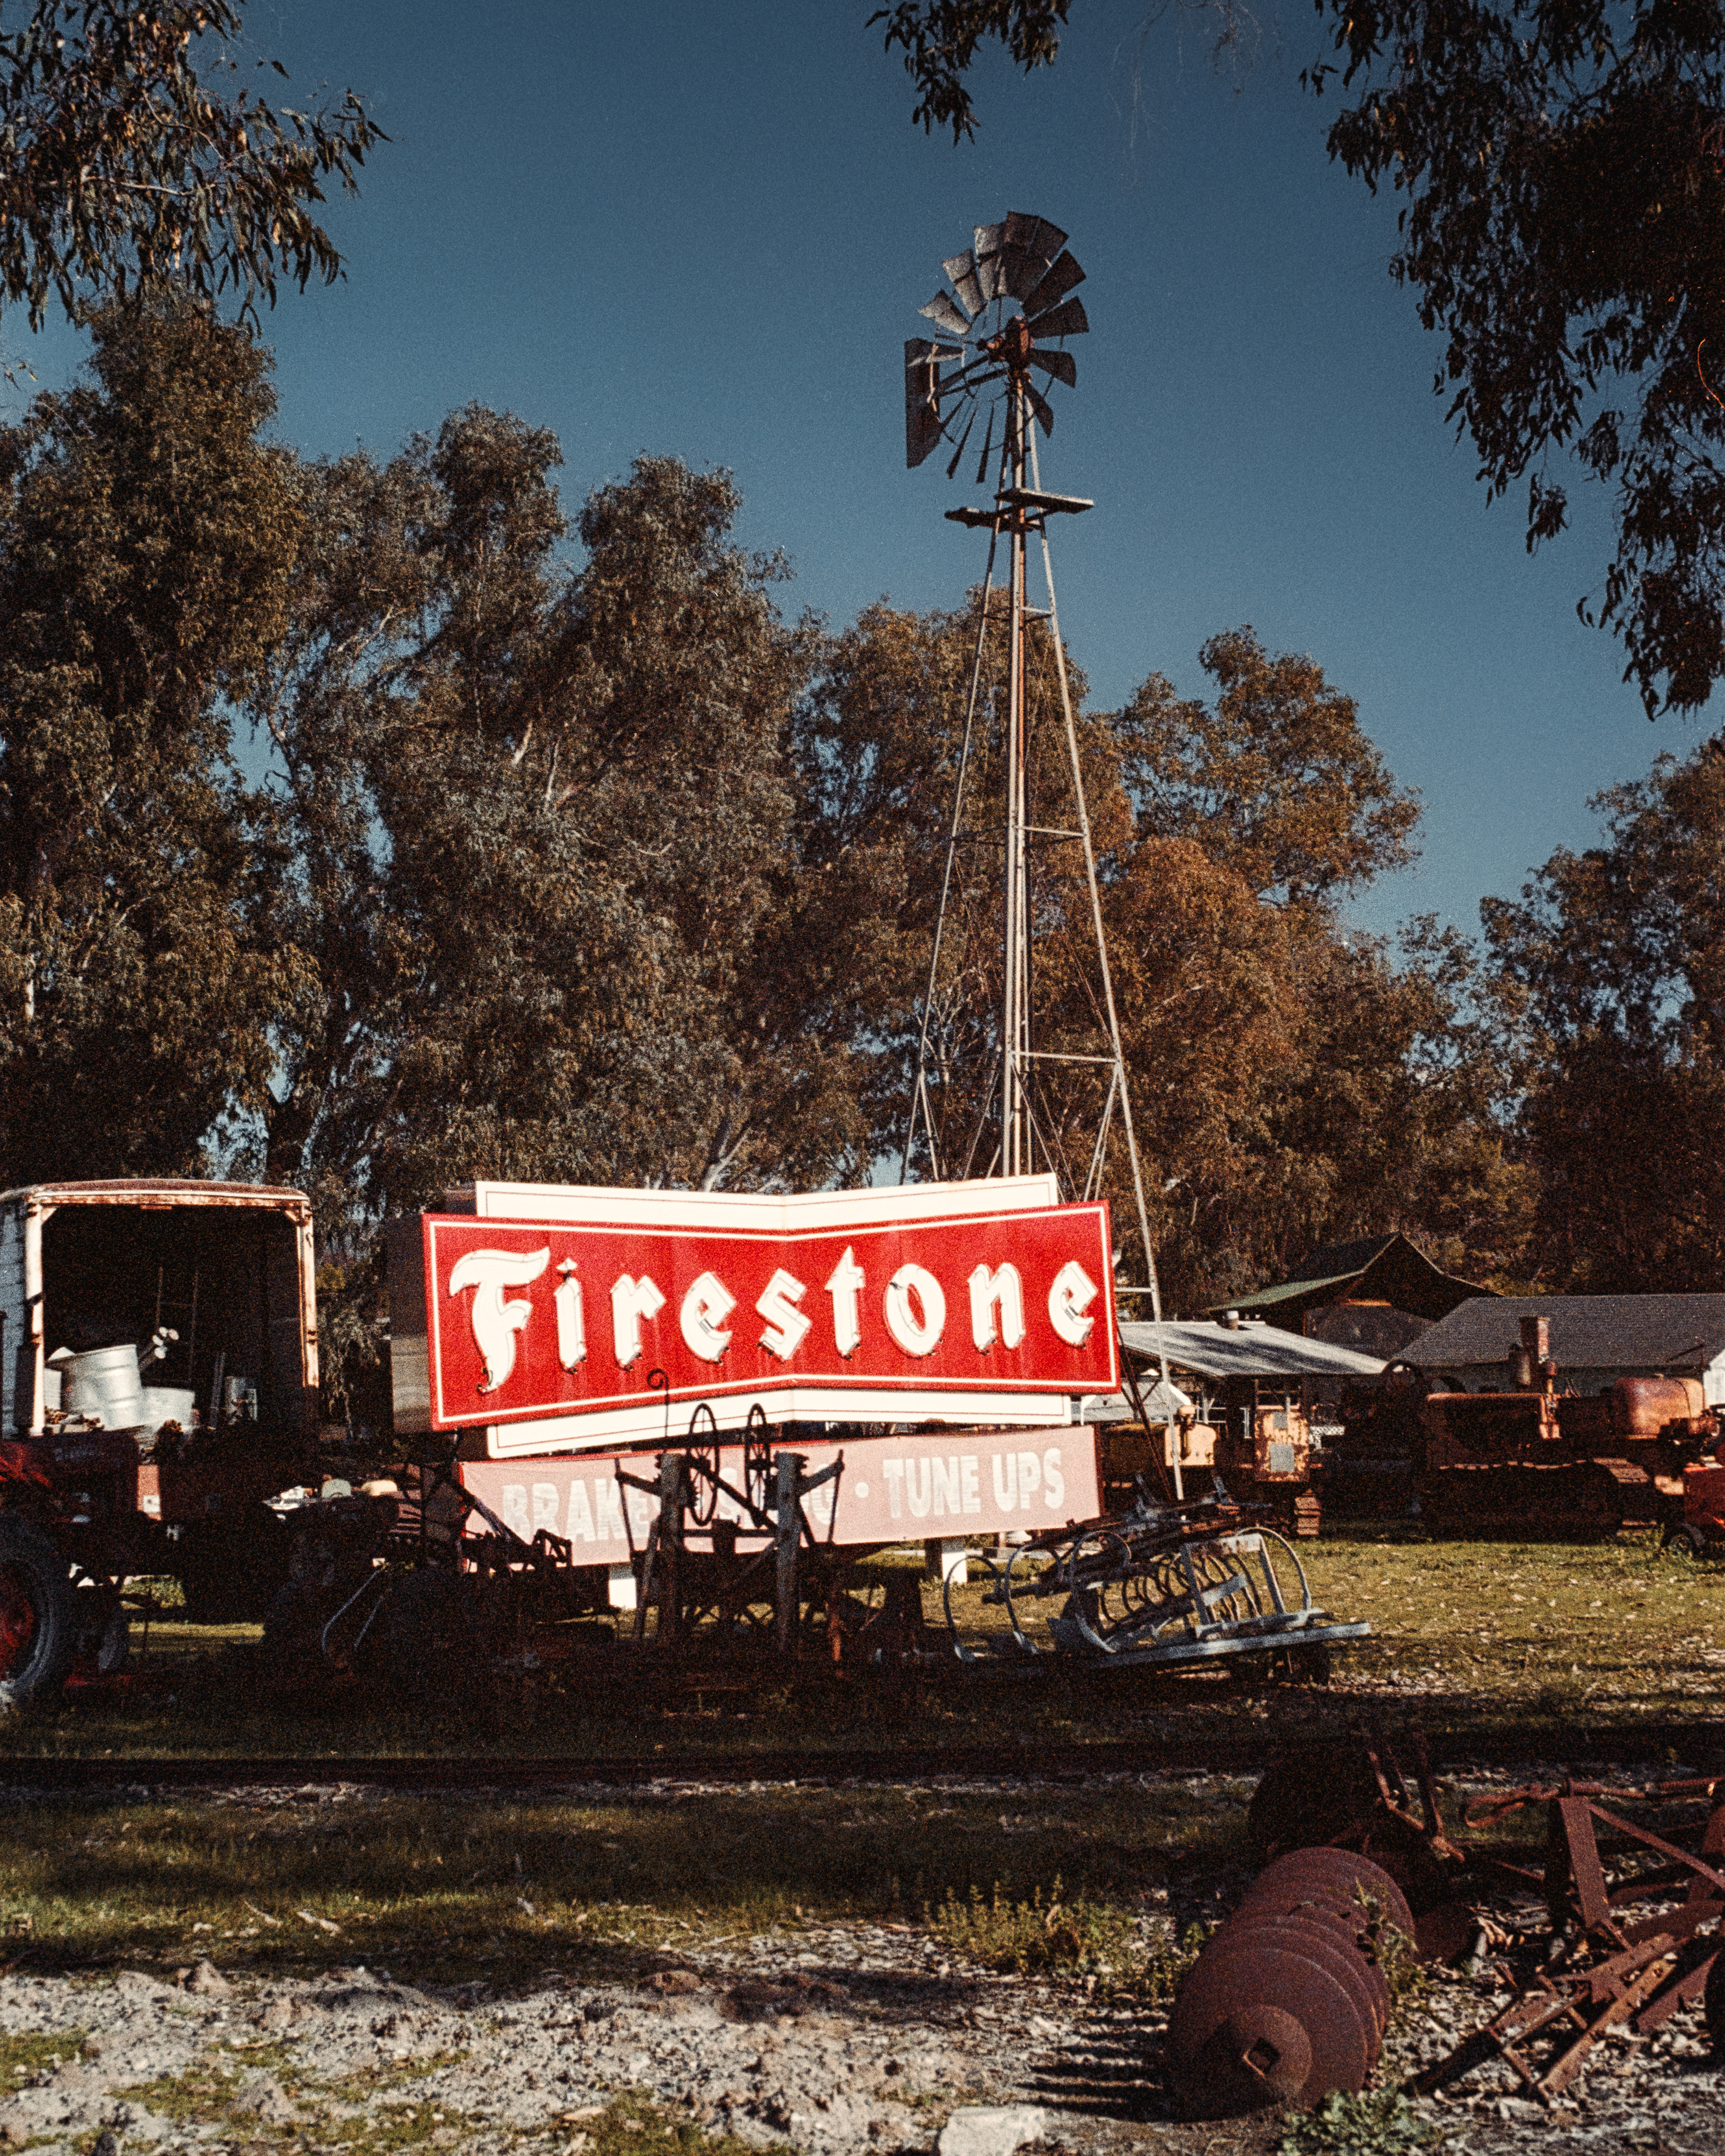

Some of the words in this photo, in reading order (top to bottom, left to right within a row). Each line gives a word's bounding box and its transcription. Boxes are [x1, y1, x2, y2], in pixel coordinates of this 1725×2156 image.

[450, 1246, 1098, 1393] Firestone
[503, 1476, 662, 1542] BRAKE
[883, 1455, 981, 1518] TUNE
[992, 1448, 1065, 1511] UPS
